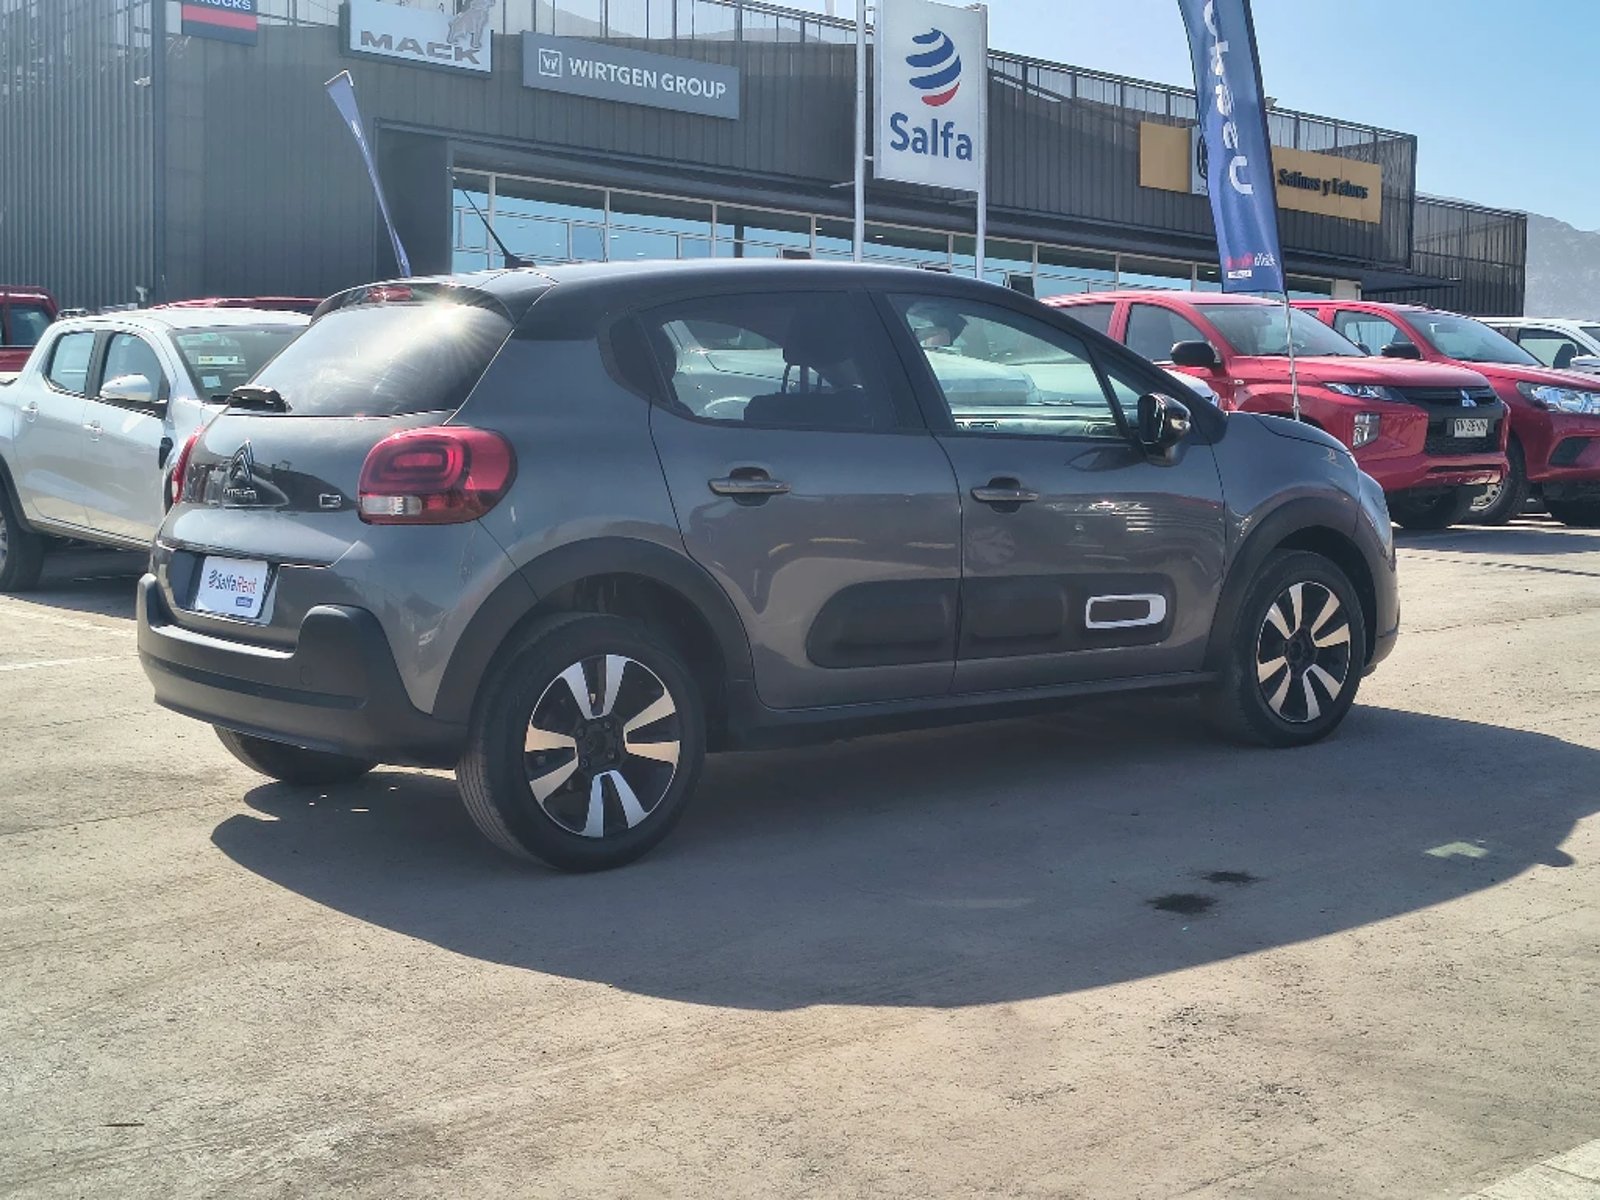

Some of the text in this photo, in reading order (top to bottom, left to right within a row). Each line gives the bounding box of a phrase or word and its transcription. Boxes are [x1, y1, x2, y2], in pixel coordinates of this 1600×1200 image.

[361, 30, 481, 65] MACK
[568, 56, 727, 100] WIRTGEN GROUP
[890, 111, 973, 162] Salfa
[1321, 179, 1331, 196] y
